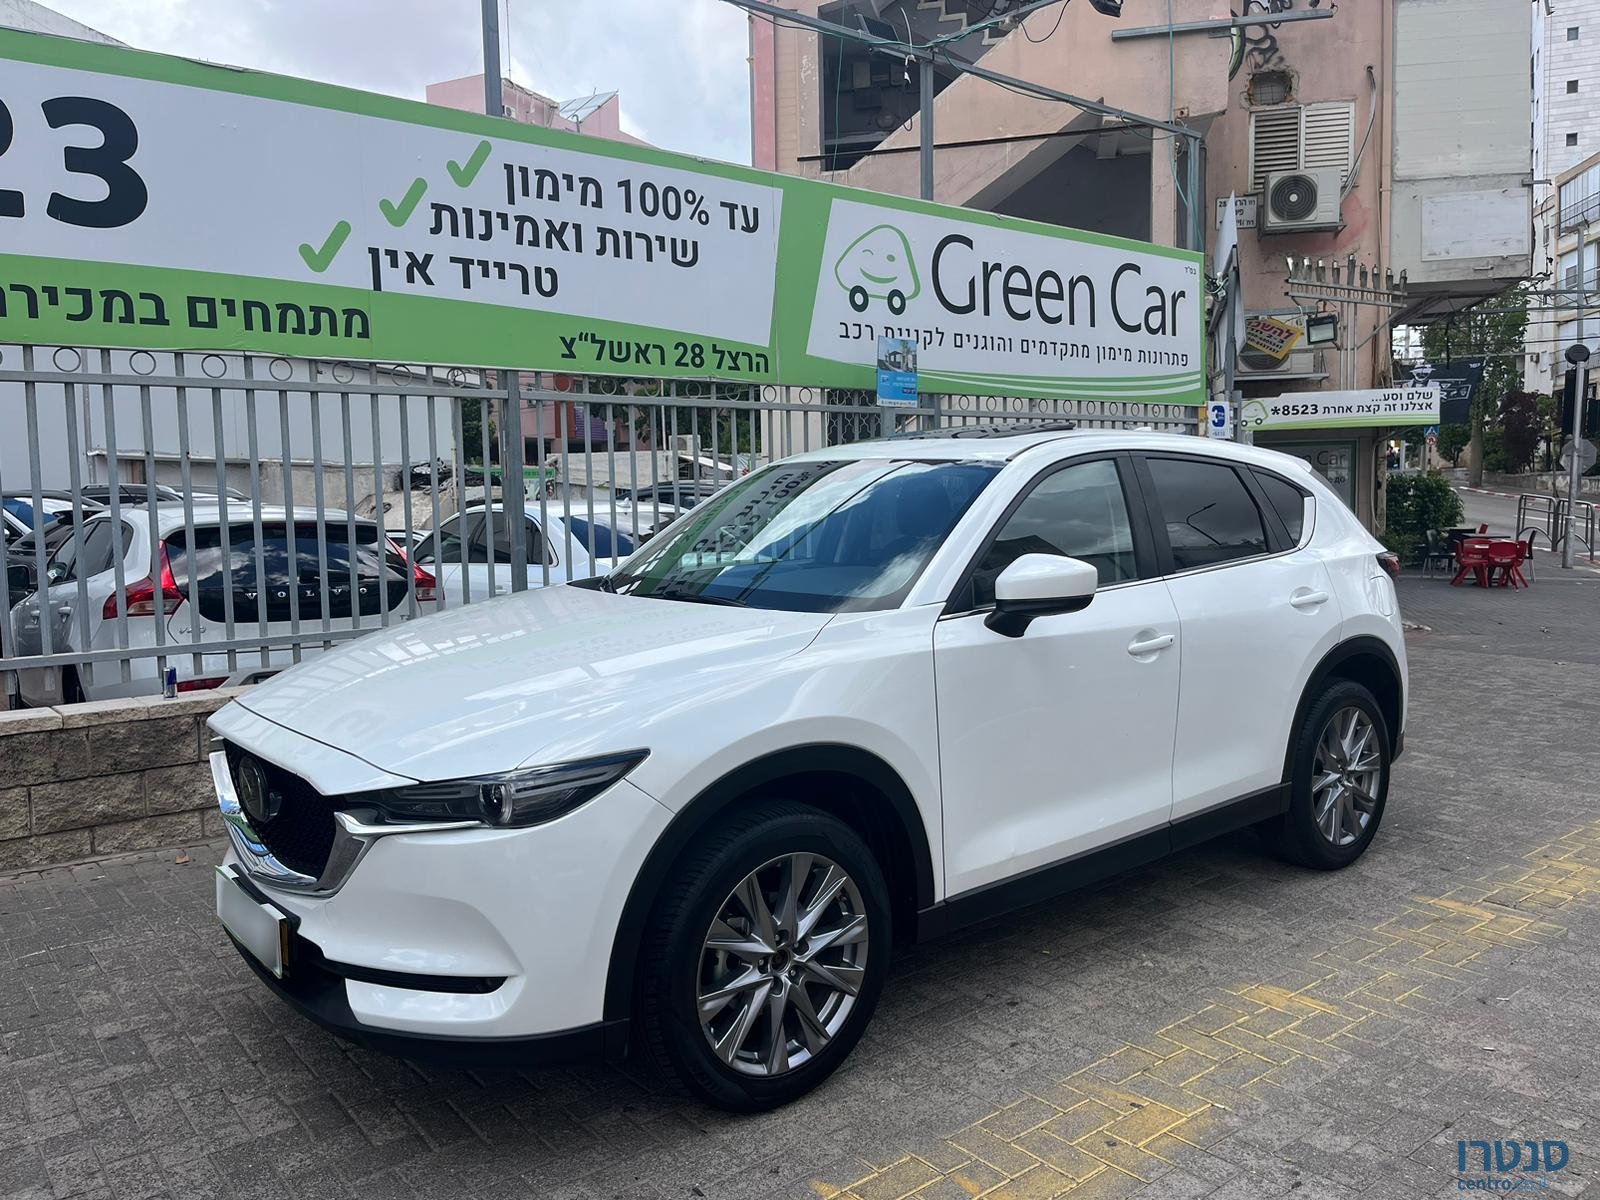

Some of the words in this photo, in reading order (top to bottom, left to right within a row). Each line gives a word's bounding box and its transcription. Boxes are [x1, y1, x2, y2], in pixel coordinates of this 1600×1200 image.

[502, 162, 604, 210] מימון
[617, 178, 711, 227] 100%
[429, 202, 584, 254] ואמינות
[719, 200, 760, 234] עד
[595, 224, 700, 269] שירות
[367, 246, 436, 292] אין
[449, 255, 560, 298] טרייד
[930, 233, 1096, 329] Green
[1110, 262, 1188, 338] Car
[185, 295, 371, 340] מתמחים
[839, 321, 874, 341] רכב
[953, 332, 1013, 353] והוגנים
[673, 341, 706, 369] 28
[710, 343, 770, 374] הרצל
[1020, 339, 1090, 361] מתקדמים
[1096, 344, 1132, 364] מימון
[1137, 348, 1189, 368] פתרונות
[1384, 403, 1398, 412] זה
[1400, 401, 1434, 412] אצלנו
[1406, 390, 1434, 401] שלם
[1322, 405, 1353, 415] אחרת
[1356, 404, 1381, 415] קצת
[245, 587, 368, 600] VOLVO
